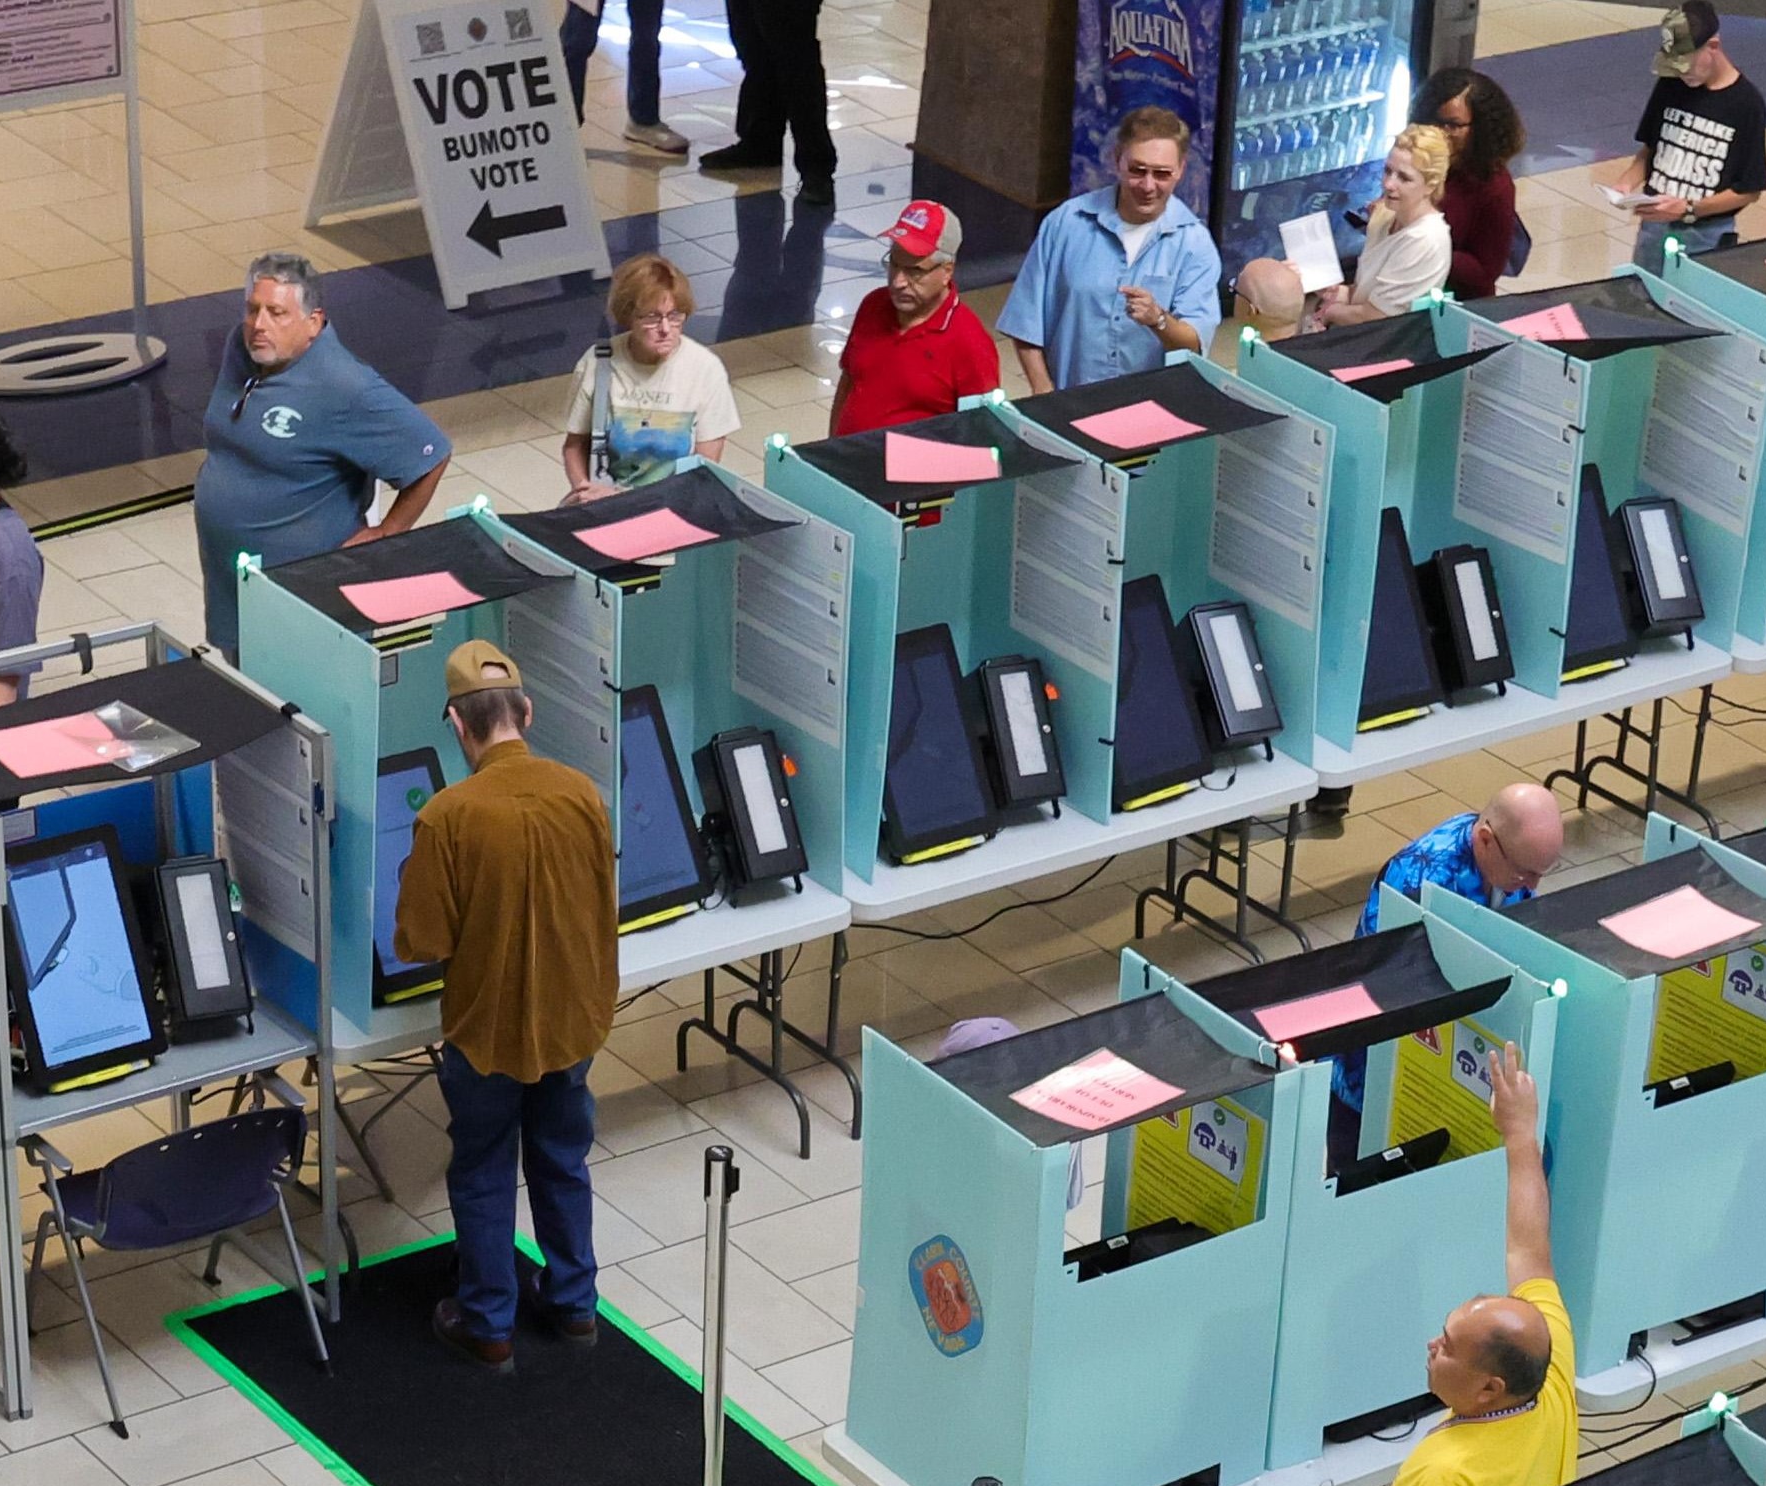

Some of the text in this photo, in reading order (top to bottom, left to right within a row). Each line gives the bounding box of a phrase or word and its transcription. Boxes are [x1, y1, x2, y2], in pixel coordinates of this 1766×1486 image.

[1108, 6, 1194, 76] AQUAFINA
[412, 56, 557, 125] VOTE
[442, 121, 551, 162] BUMOTO
[1660, 122, 1729, 159] AMERICA
[1692, 115, 1736, 142] MAKE
[469, 157, 539, 191] VOTE
